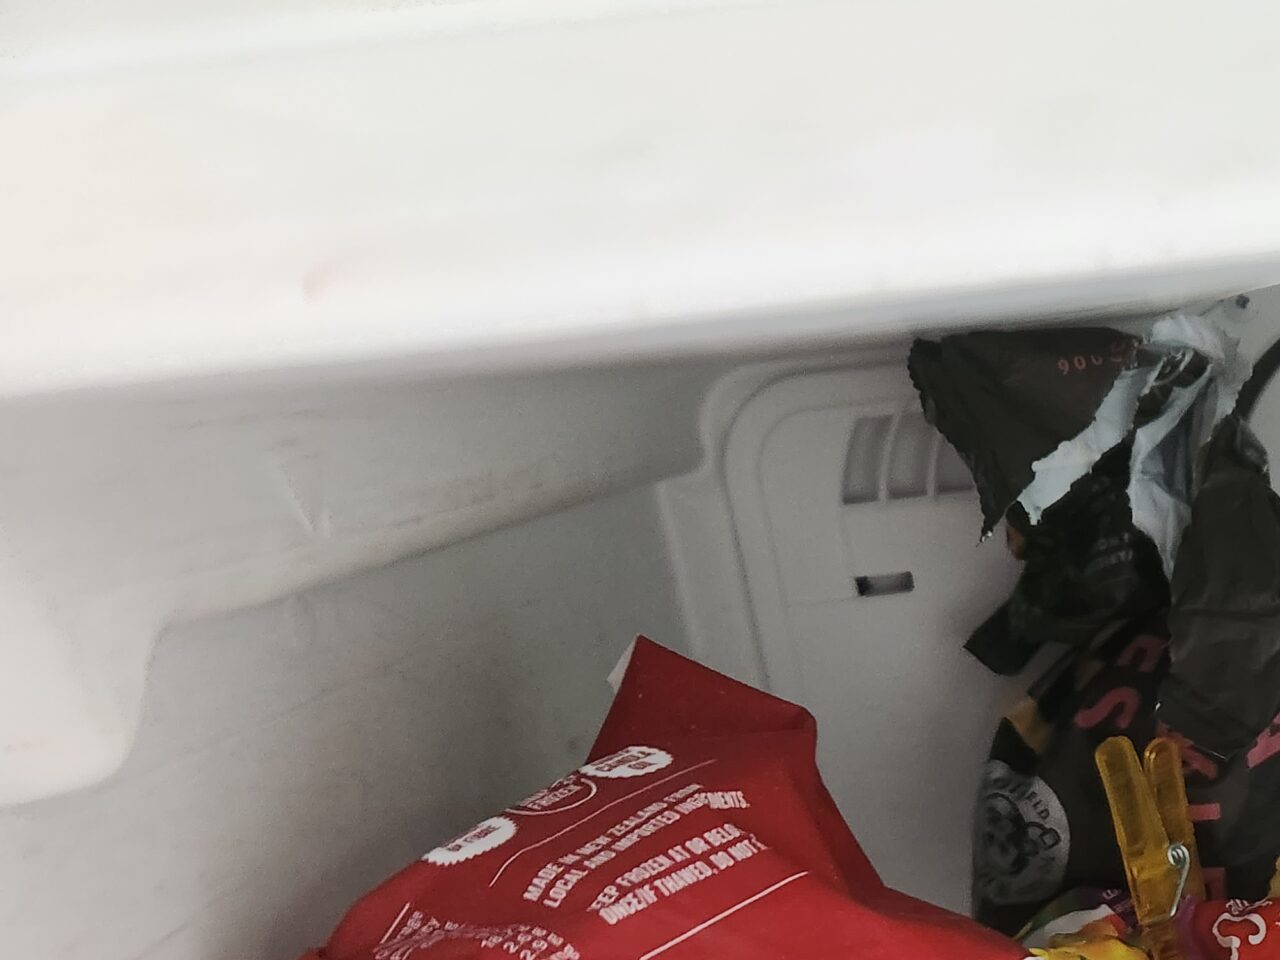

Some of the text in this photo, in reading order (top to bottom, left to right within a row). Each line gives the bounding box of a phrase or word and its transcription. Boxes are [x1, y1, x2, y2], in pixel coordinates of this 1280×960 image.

[523, 862, 565, 902] MADE
[576, 835, 612, 855] NEW
[543, 869, 589, 908] LOCAL
[583, 850, 617, 869] AND
[615, 854, 675, 887] FROZEN
[667, 845, 691, 863] AT
[684, 837, 711, 855] OR
[703, 823, 747, 847] BELO
[709, 851, 735, 870] DO
